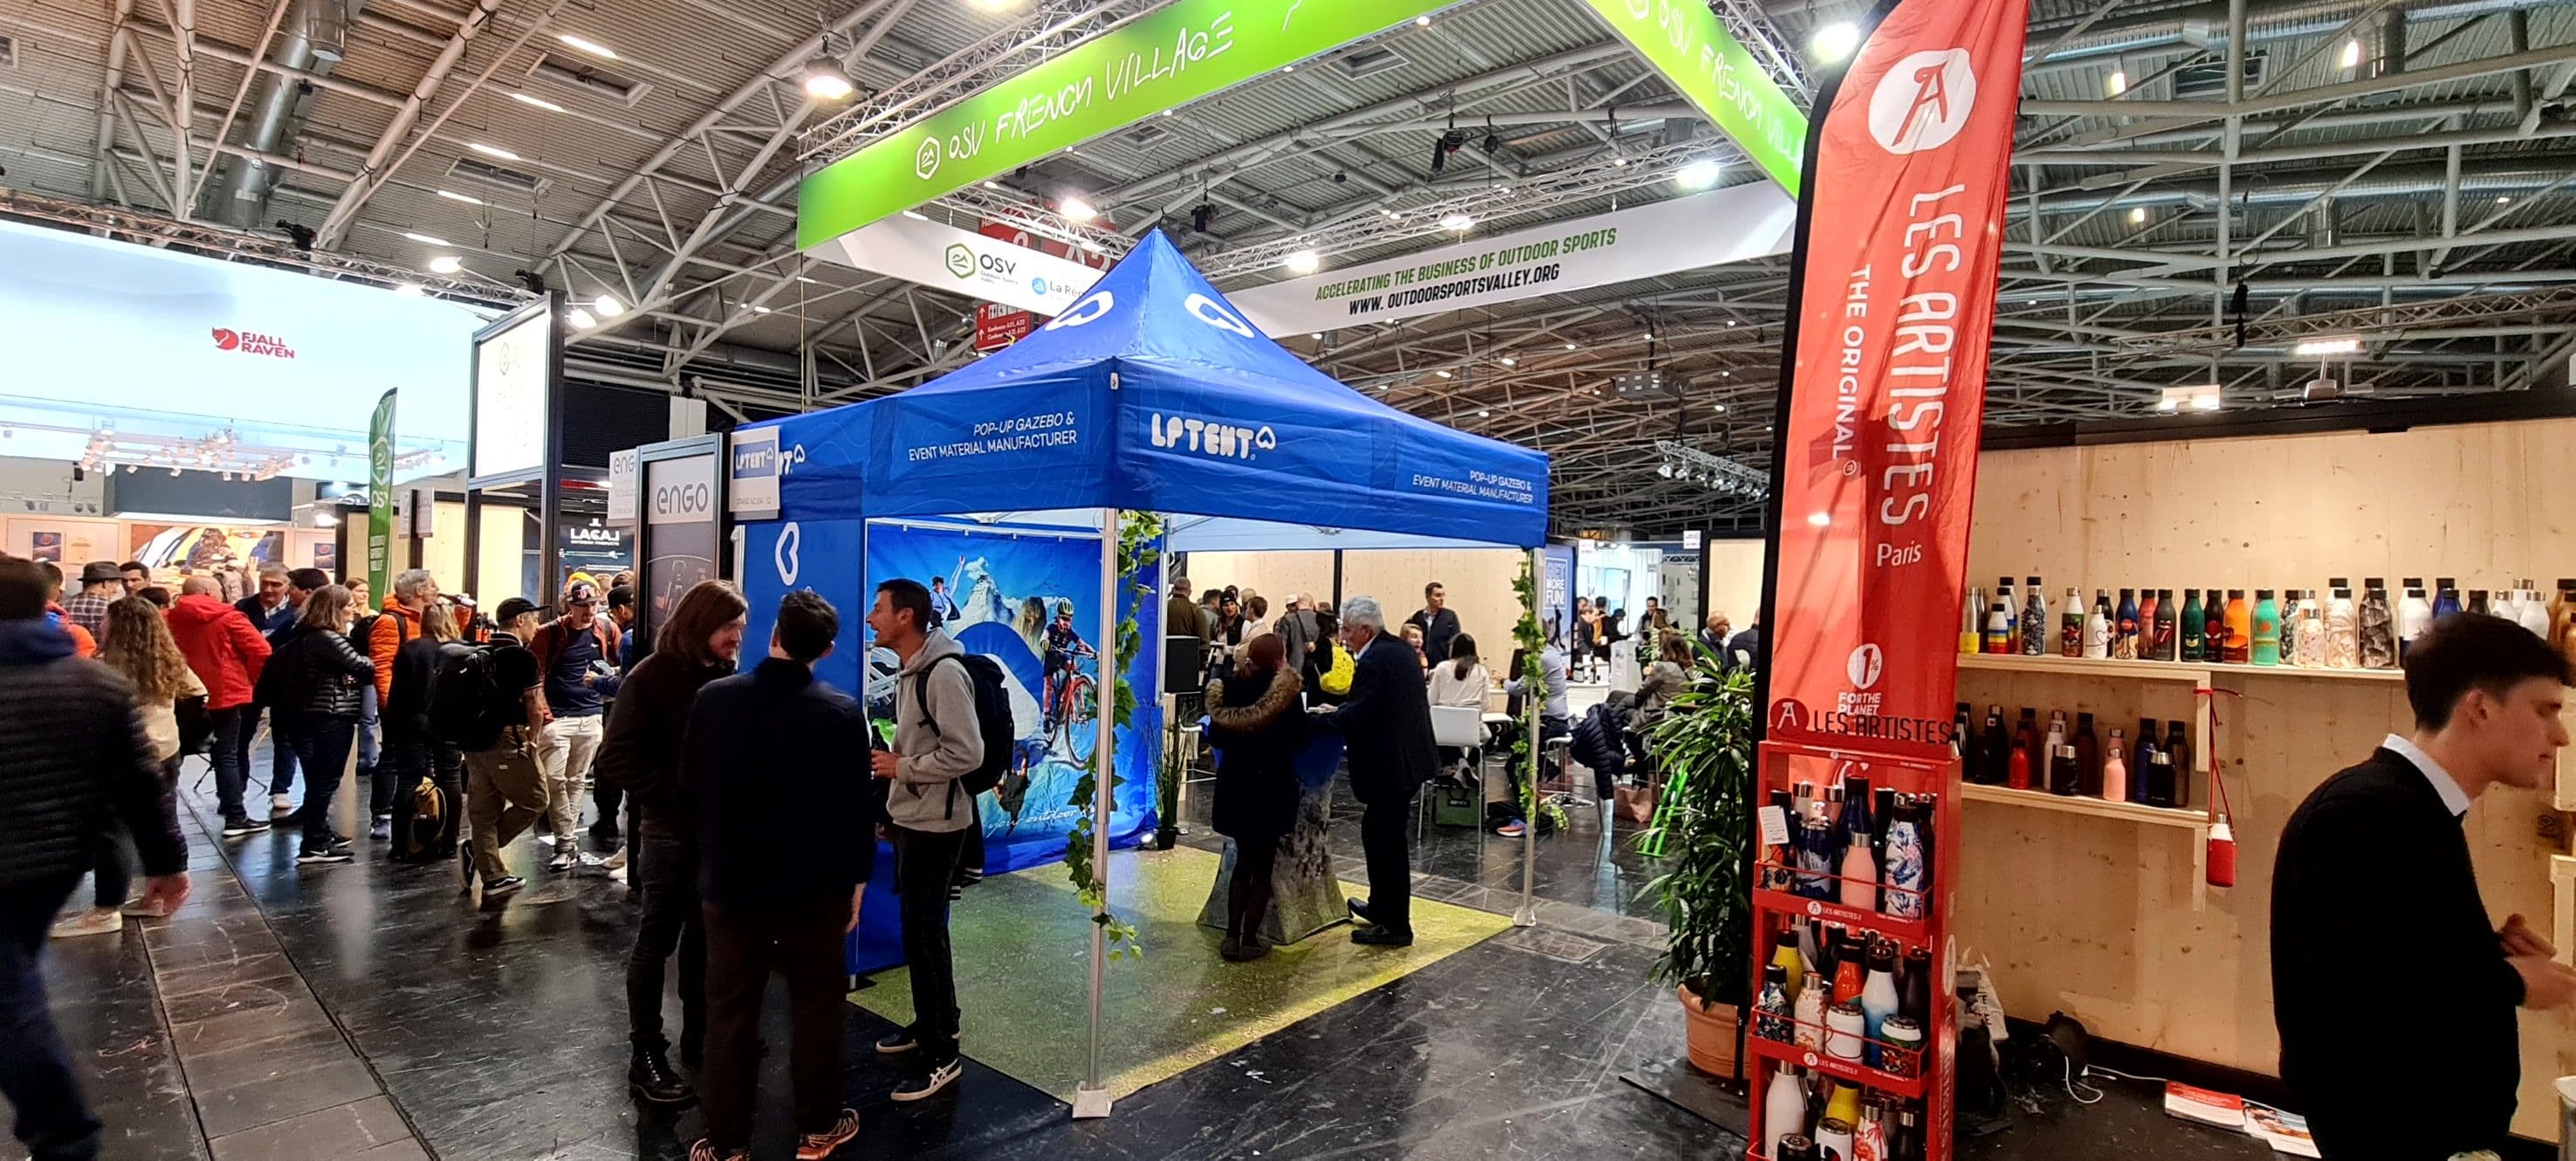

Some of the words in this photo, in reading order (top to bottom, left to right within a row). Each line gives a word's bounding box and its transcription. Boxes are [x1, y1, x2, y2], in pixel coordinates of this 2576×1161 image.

[949, 120, 986, 160] OSV
[995, 77, 1092, 144] FRENCH
[1105, 11, 1233, 101] VILLAGE
[1900, 183, 1965, 279] LES
[979, 254, 1017, 275] OSV
[1315, 272, 1391, 301] ACCELERATING
[1394, 267, 1416, 287] THE
[1417, 256, 1477, 283] BUSINESS
[1480, 252, 1496, 270] OF
[1498, 239, 1559, 268] OUTDOOR
[1563, 228, 1618, 255] SPORTS
[1050, 281, 1062, 293] La
[1349, 296, 1384, 315] WWW.
[1387, 263, 1561, 309] OUTDOORSPORTSVALLEY.ORG
[1845, 264, 1872, 319] THE
[242, 332, 286, 347] FJALL
[242, 342, 295, 359] RAVEN
[1831, 325, 1865, 461] ORIGINAL
[973, 420, 1013, 436] POP-UP
[1015, 413, 1063, 431] GAZEBO
[1066, 411, 1075, 425] &
[1880, 291, 1959, 526] ARTISTES
[908, 446, 938, 461] EVENT
[939, 440, 986, 457] MATERIAL
[987, 429, 1078, 452] MANUFACTURER
[1412, 474, 1440, 488] EVENT
[1441, 479, 1477, 495] MATERIAL
[1479, 487, 1534, 504] MANUFACTURER
[1469, 470, 1498, 484] POP-UP
[1499, 476, 1526, 490] GAZEBO
[1526, 481, 1533, 491] &
[1877, 540, 1922, 567] Paris
[1546, 578, 1565, 590] MORE
[1546, 590, 1565, 605] FUN!
[1838, 704, 1880, 716] PLANET
[1814, 710, 1849, 735] LES
[1855, 715, 1954, 744] ARTISTES
[986, 817, 1024, 838] your
[1026, 807, 1078, 823] outdoor
